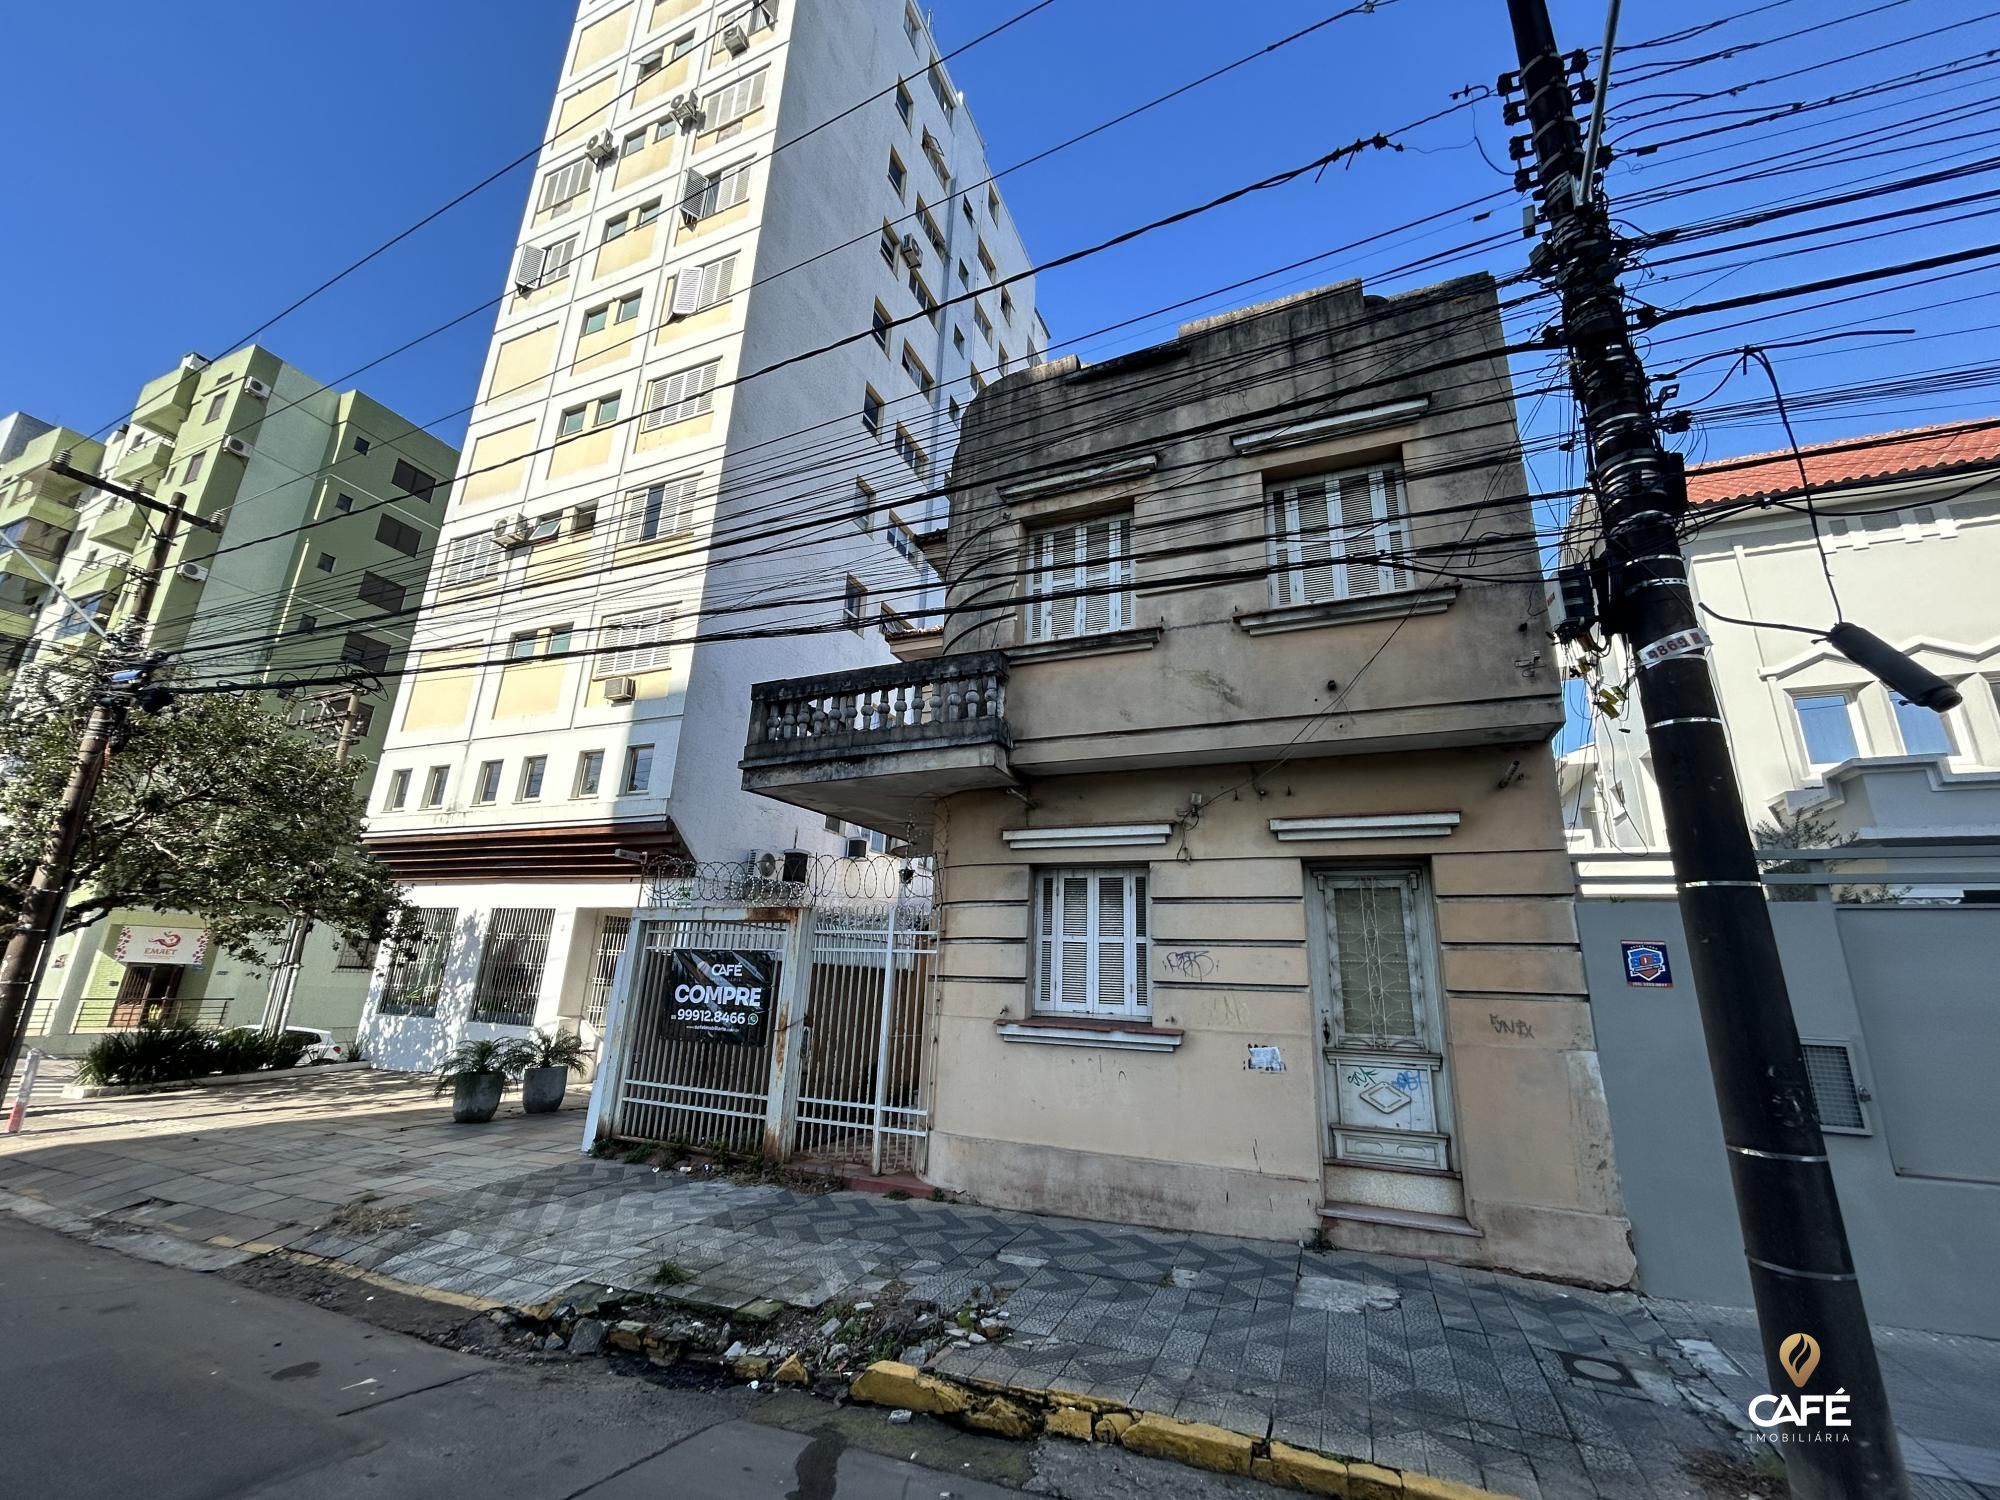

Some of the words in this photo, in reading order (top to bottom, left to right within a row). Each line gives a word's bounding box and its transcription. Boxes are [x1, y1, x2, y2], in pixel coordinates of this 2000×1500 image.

[711, 961, 743, 977] CAFÉ
[674, 984, 762, 1007] COMPRE
[677, 1008, 746, 1025] 99912.8466
